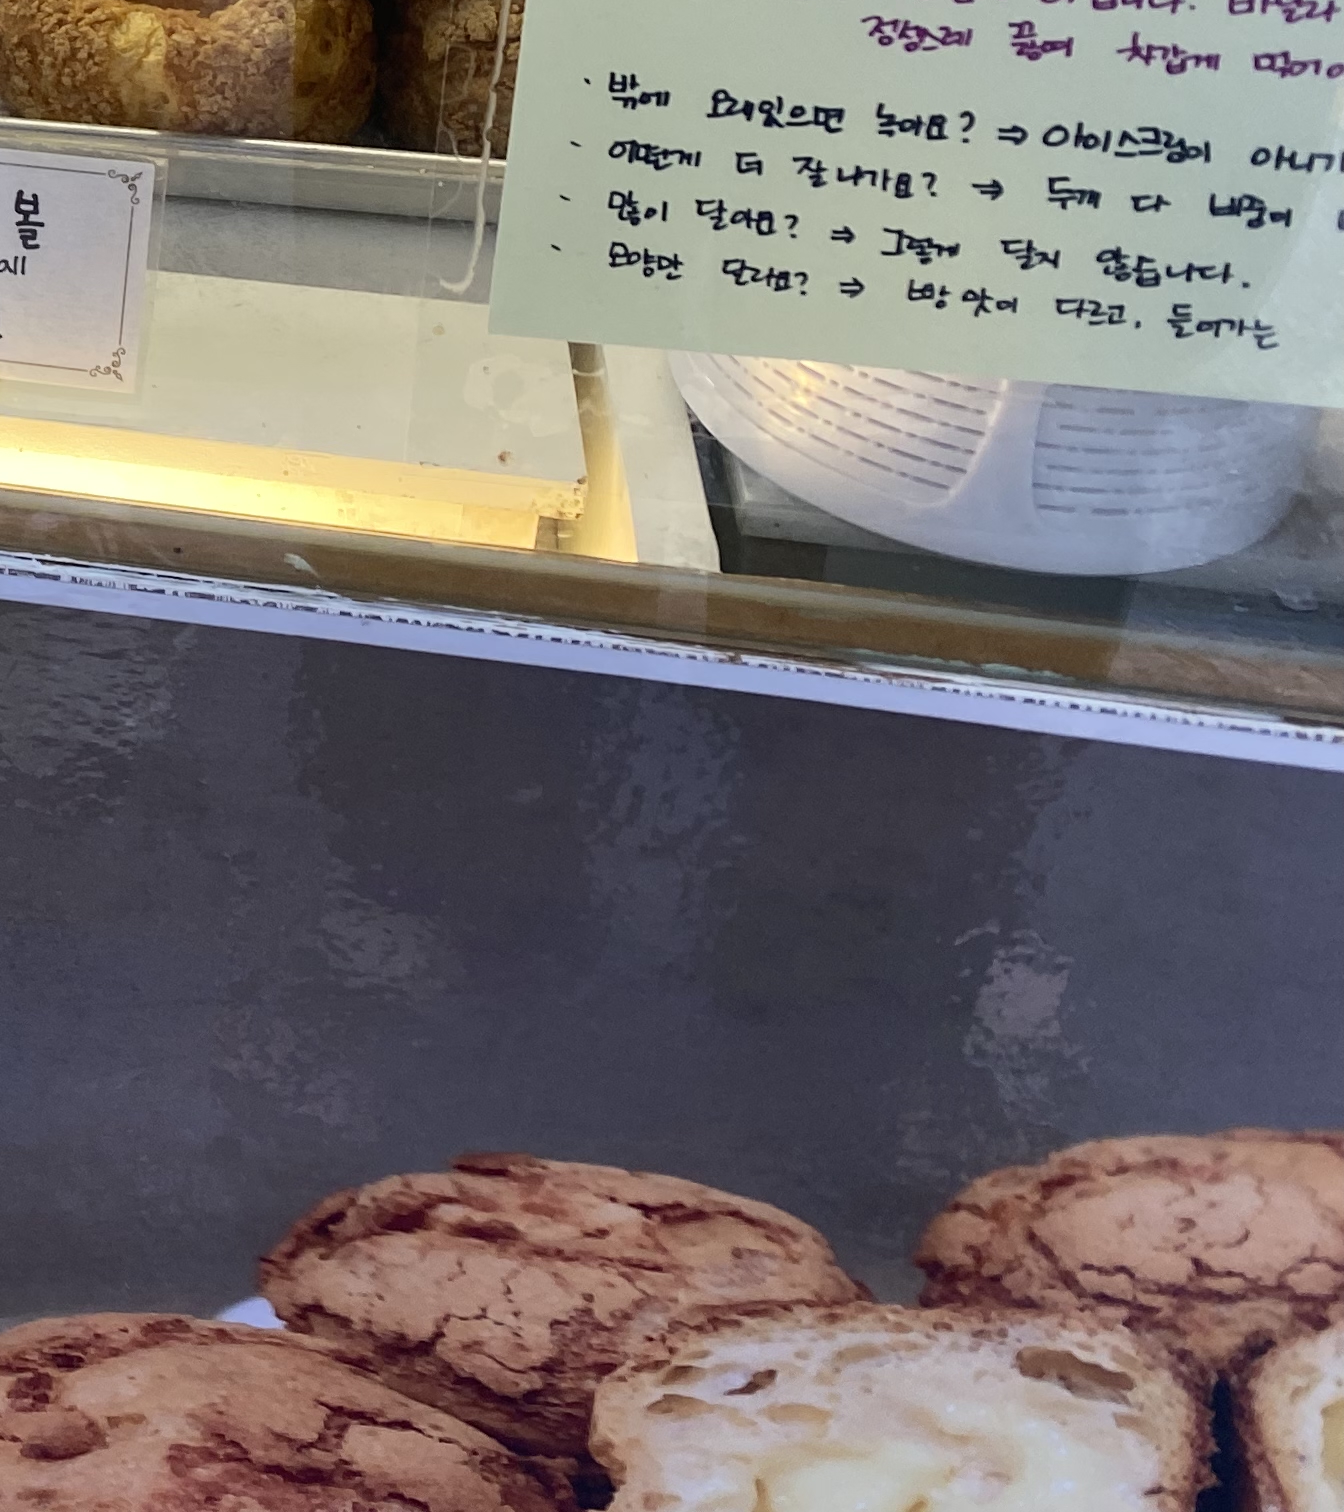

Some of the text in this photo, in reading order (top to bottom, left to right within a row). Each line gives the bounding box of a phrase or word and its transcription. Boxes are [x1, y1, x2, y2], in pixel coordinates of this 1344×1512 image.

[1116, 31, 1221, 75] 차갑게
[608, 71, 671, 110] 밖에
[1042, 122, 1212, 164] 아이스크림이
[735, 151, 763, 176] 더
[1131, 193, 1172, 213] 다
[607, 190, 668, 226] 많이
[1000, 239, 1060, 270] 달지
[608, 241, 684, 280] 모양만
[907, 278, 952, 309] 빵
[1166, 303, 1281, 351] 들어가는
